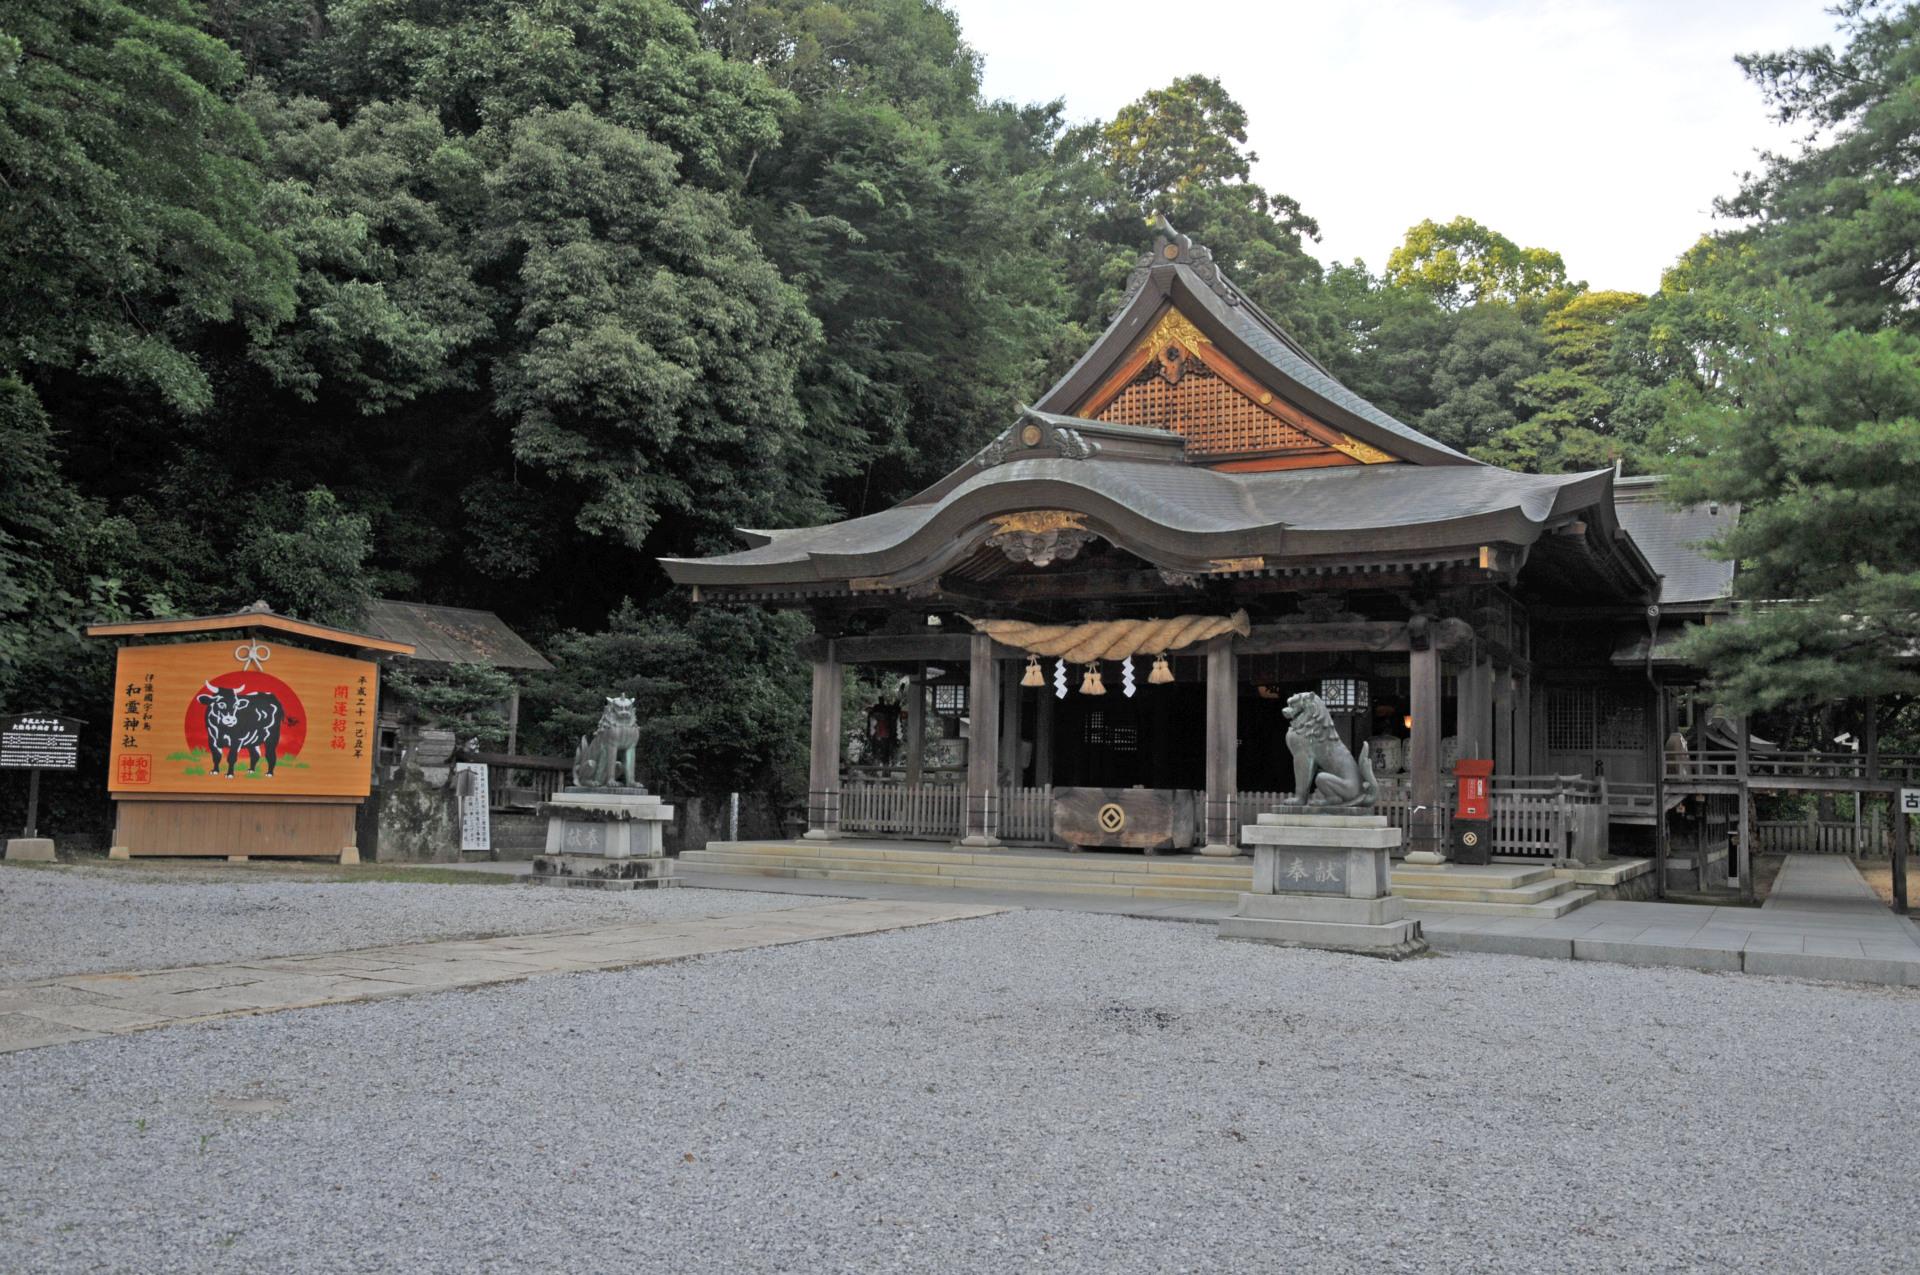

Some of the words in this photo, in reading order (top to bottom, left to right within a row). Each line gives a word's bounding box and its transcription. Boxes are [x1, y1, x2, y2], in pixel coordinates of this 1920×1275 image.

[330, 685, 349, 750] 開運招福
[1286, 857, 1341, 883] 奉献
